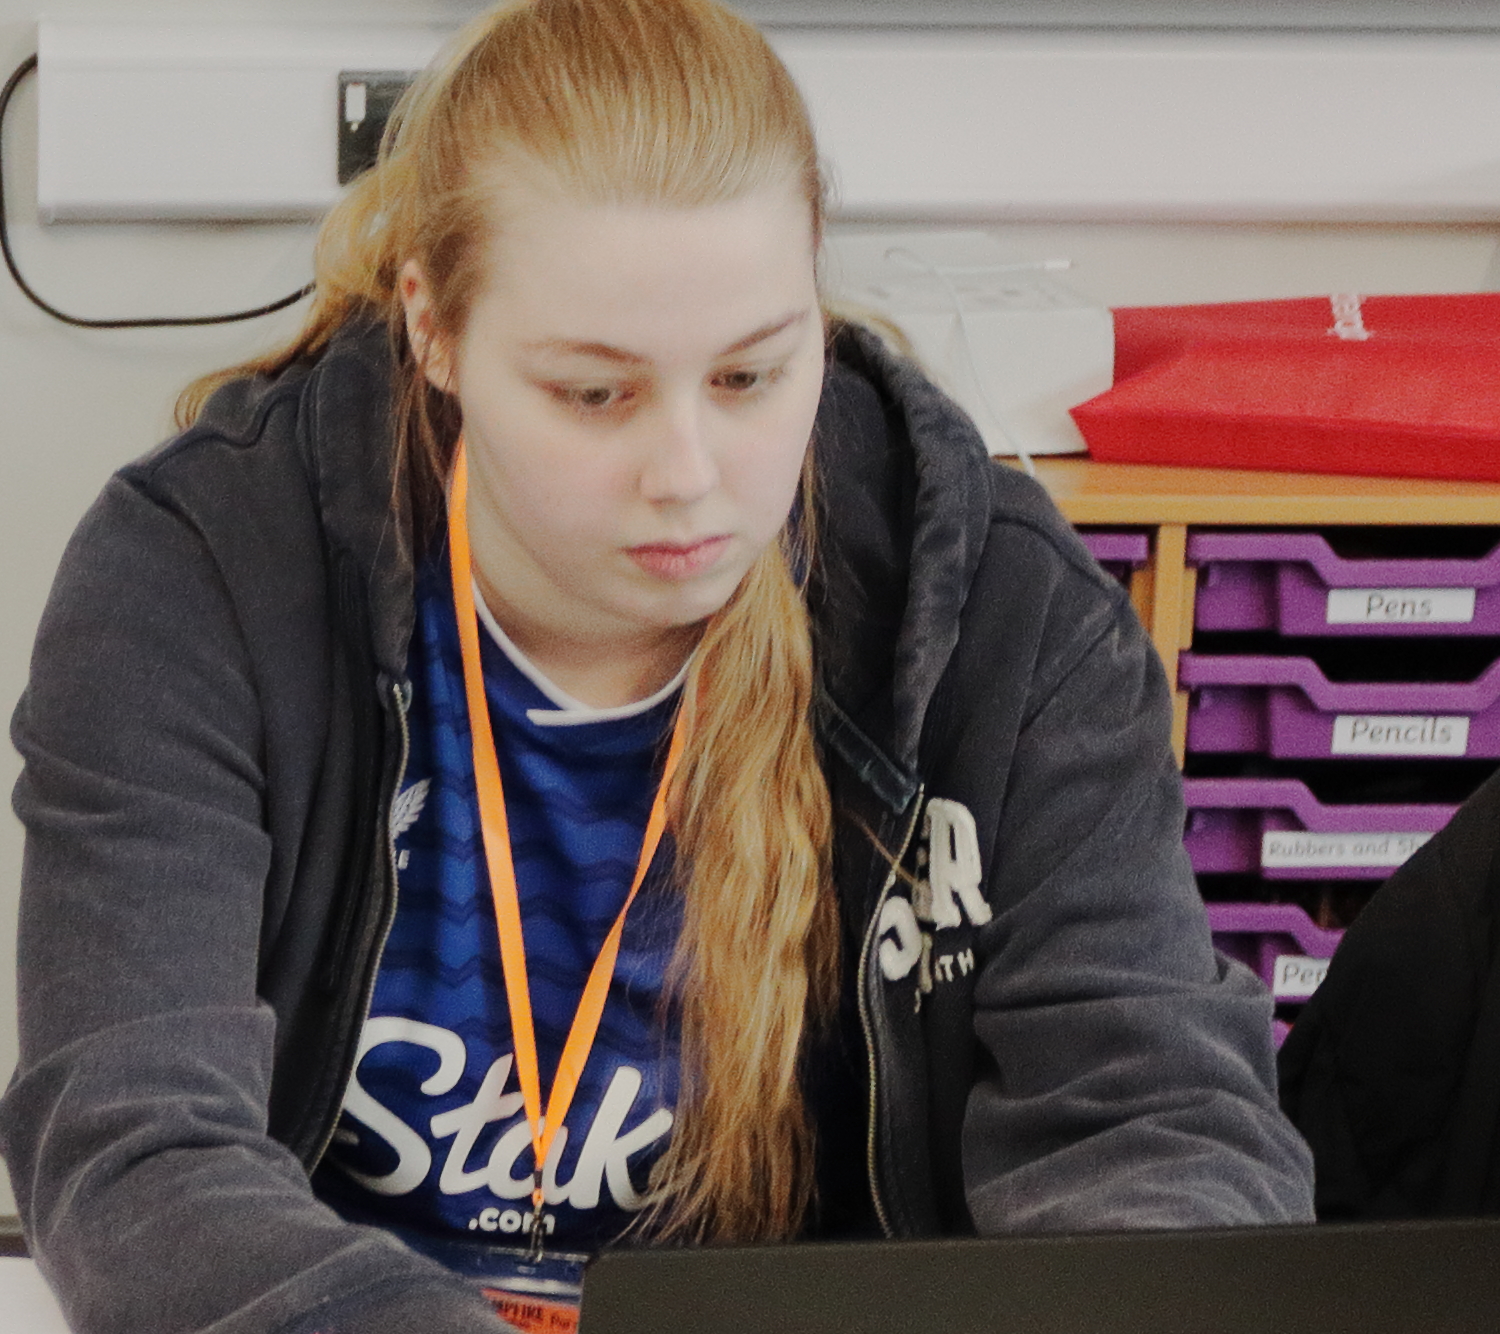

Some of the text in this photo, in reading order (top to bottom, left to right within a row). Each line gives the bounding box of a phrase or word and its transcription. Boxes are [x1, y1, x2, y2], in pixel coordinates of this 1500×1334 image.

[1366, 591, 1432, 618] Pens
[1351, 717, 1453, 745] Pencils
[1269, 841, 1345, 856] Rubbers
[1352, 838, 1390, 856] and
[326, 1016, 676, 1212] Stak
[468, 1206, 557, 1235] .com
